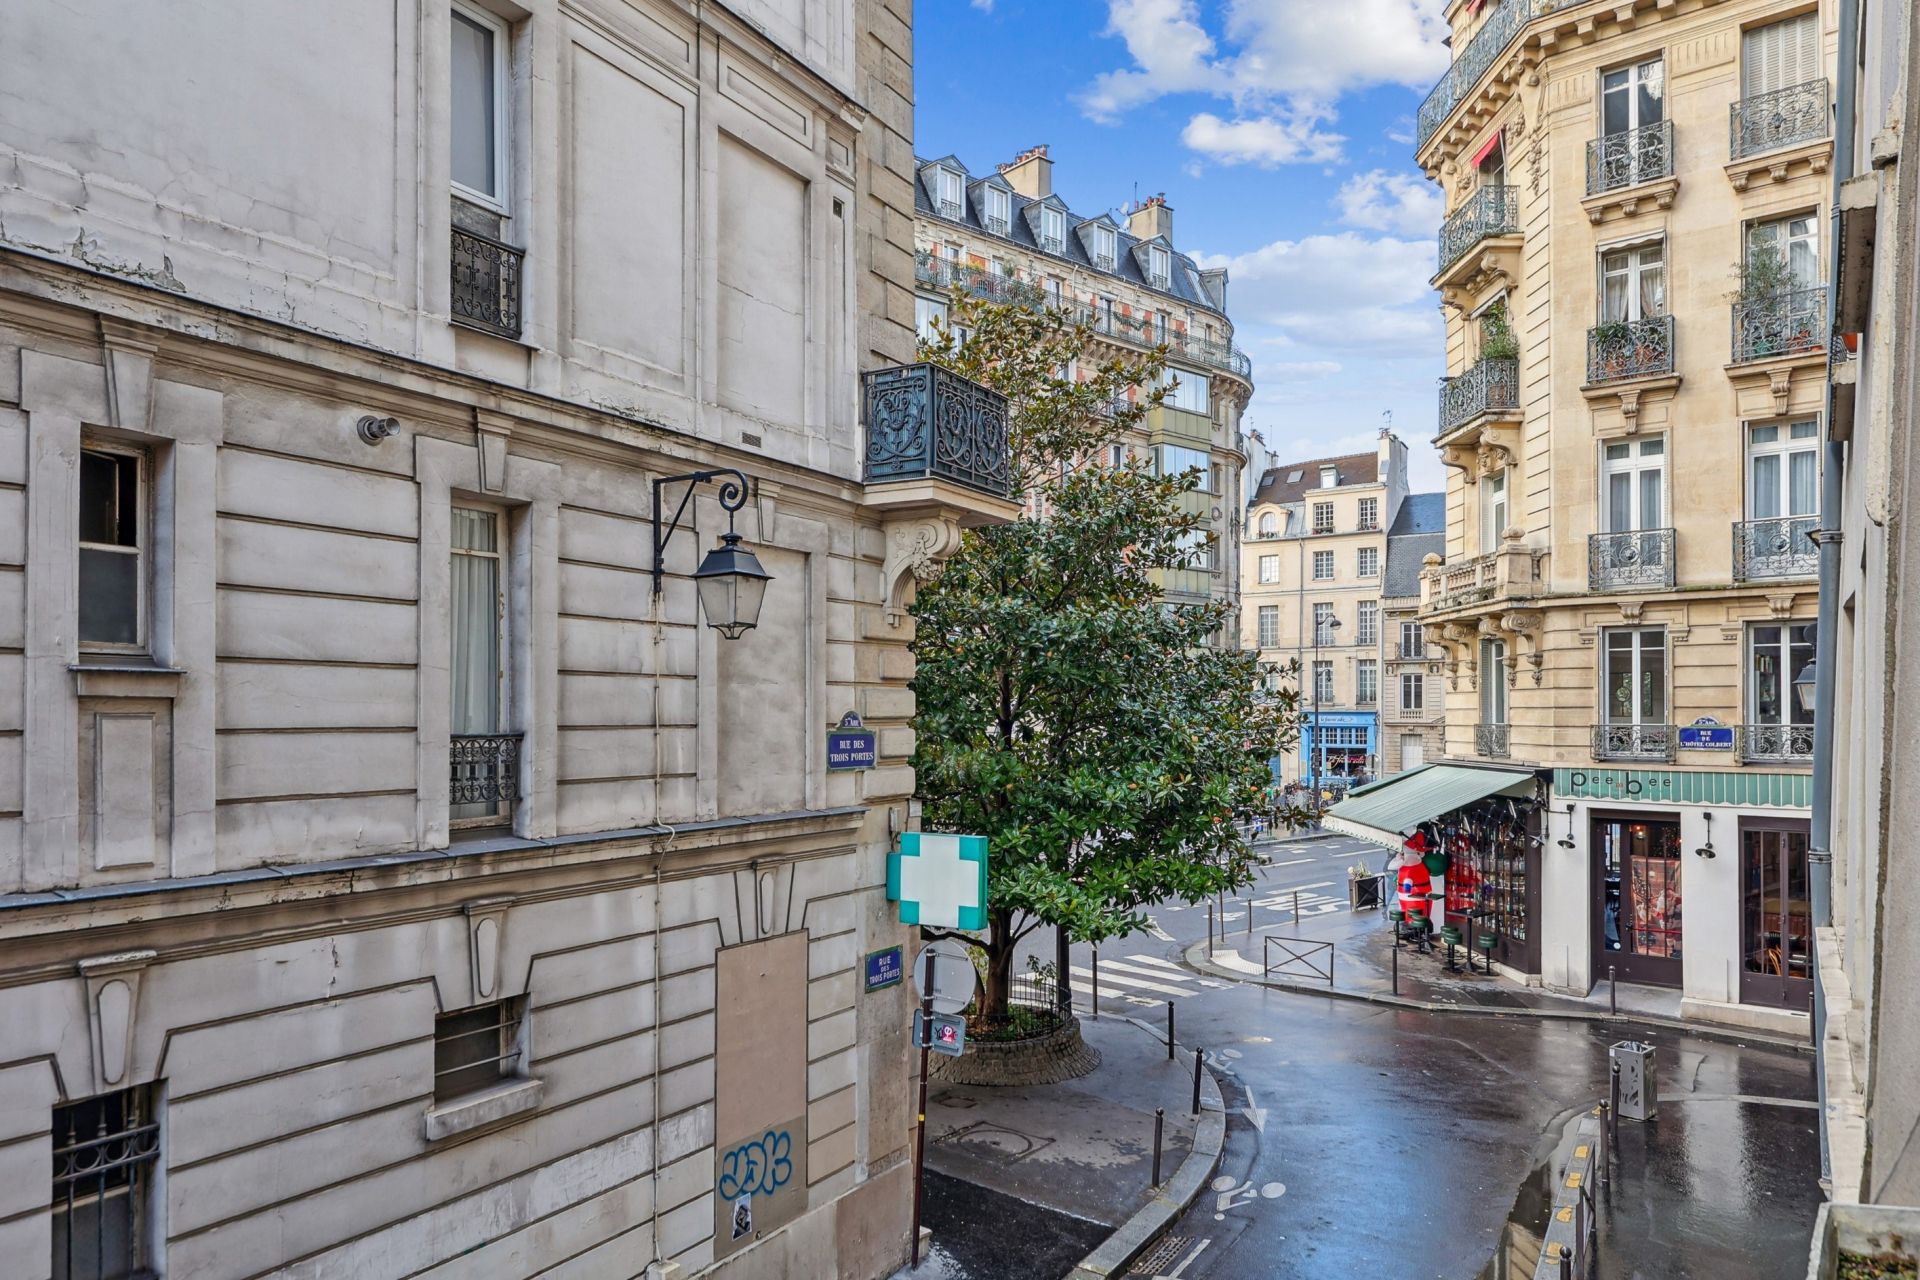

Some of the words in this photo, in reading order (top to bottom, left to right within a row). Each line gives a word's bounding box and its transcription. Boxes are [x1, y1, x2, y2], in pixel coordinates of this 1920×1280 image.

[840, 740, 851, 749] RUE
[854, 740, 864, 748] DES
[830, 753, 849, 762] TROIS
[851, 752, 873, 761] PORTES
[879, 956, 891, 966] RUE
[880, 965, 889, 973] DES
[883, 968, 899, 980] PORTES
[870, 974, 882, 984] TROIS
